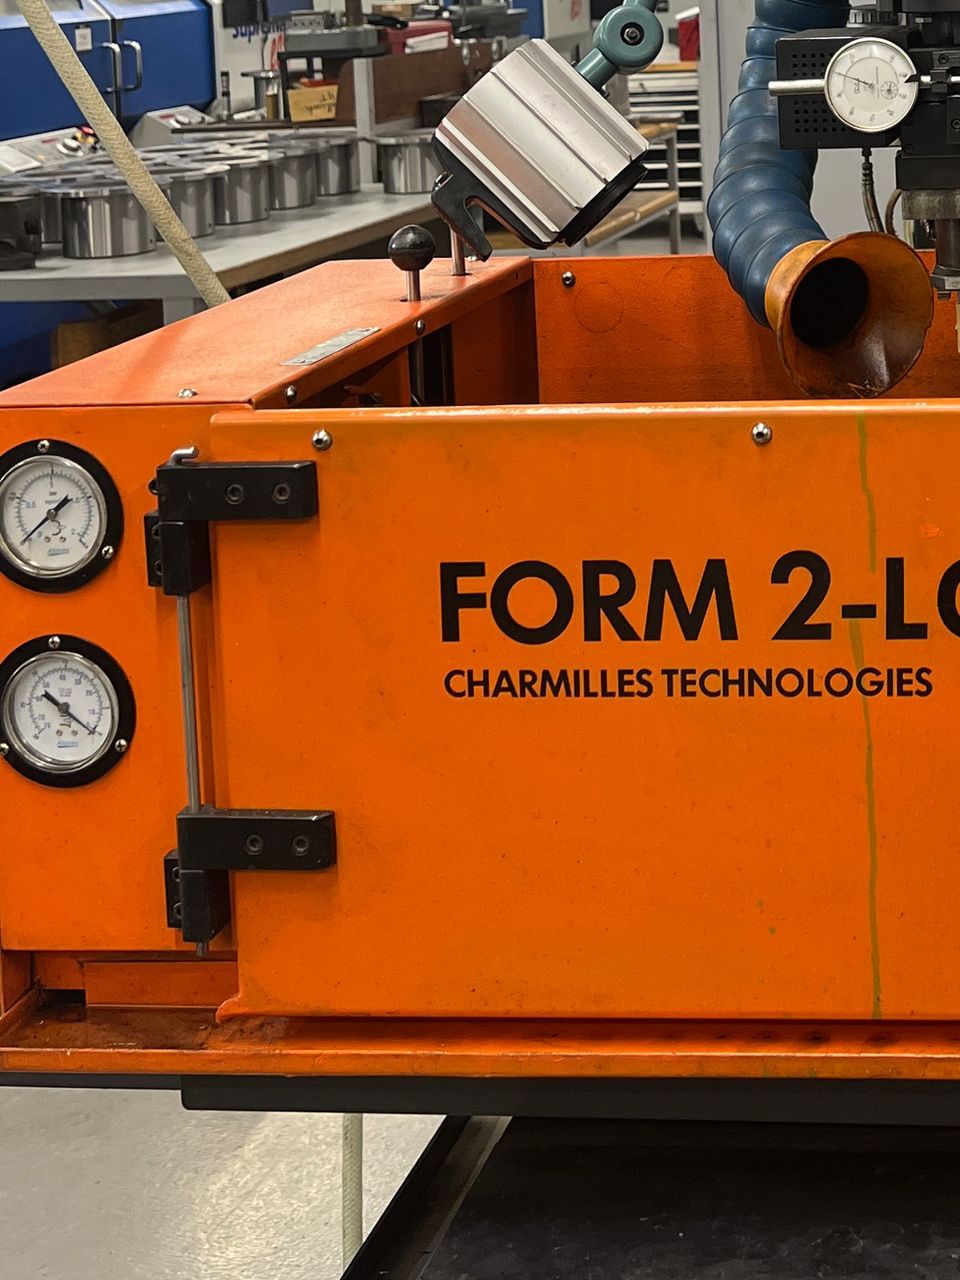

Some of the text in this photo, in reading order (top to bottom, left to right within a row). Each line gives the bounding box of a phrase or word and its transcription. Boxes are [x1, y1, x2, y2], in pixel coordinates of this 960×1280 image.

[439, 557, 739, 646] FORM
[443, 665, 933, 700] CHARMILLES TECHNOLOGIES
